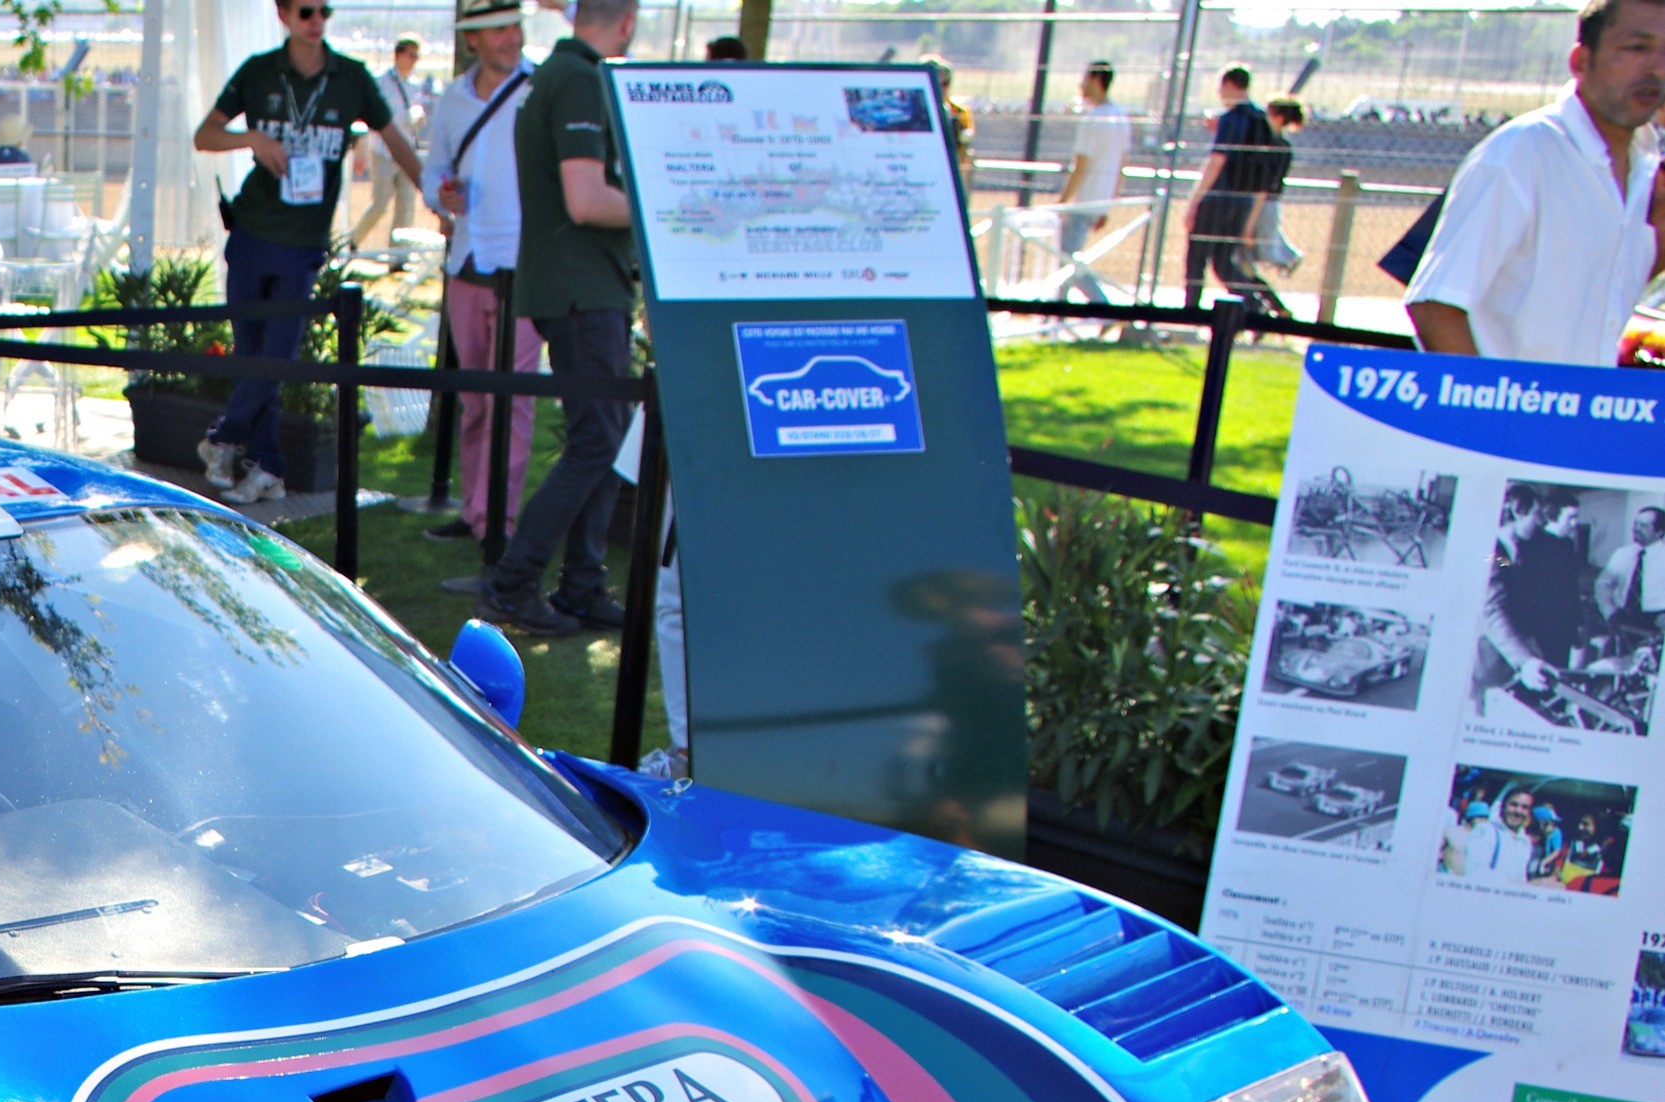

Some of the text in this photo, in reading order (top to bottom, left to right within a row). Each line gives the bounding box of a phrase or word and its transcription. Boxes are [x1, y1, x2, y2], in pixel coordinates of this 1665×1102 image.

[776, 387, 885, 413] CAR-COVER
[1338, 364, 1659, 423] 1976, Inaltéra aux
